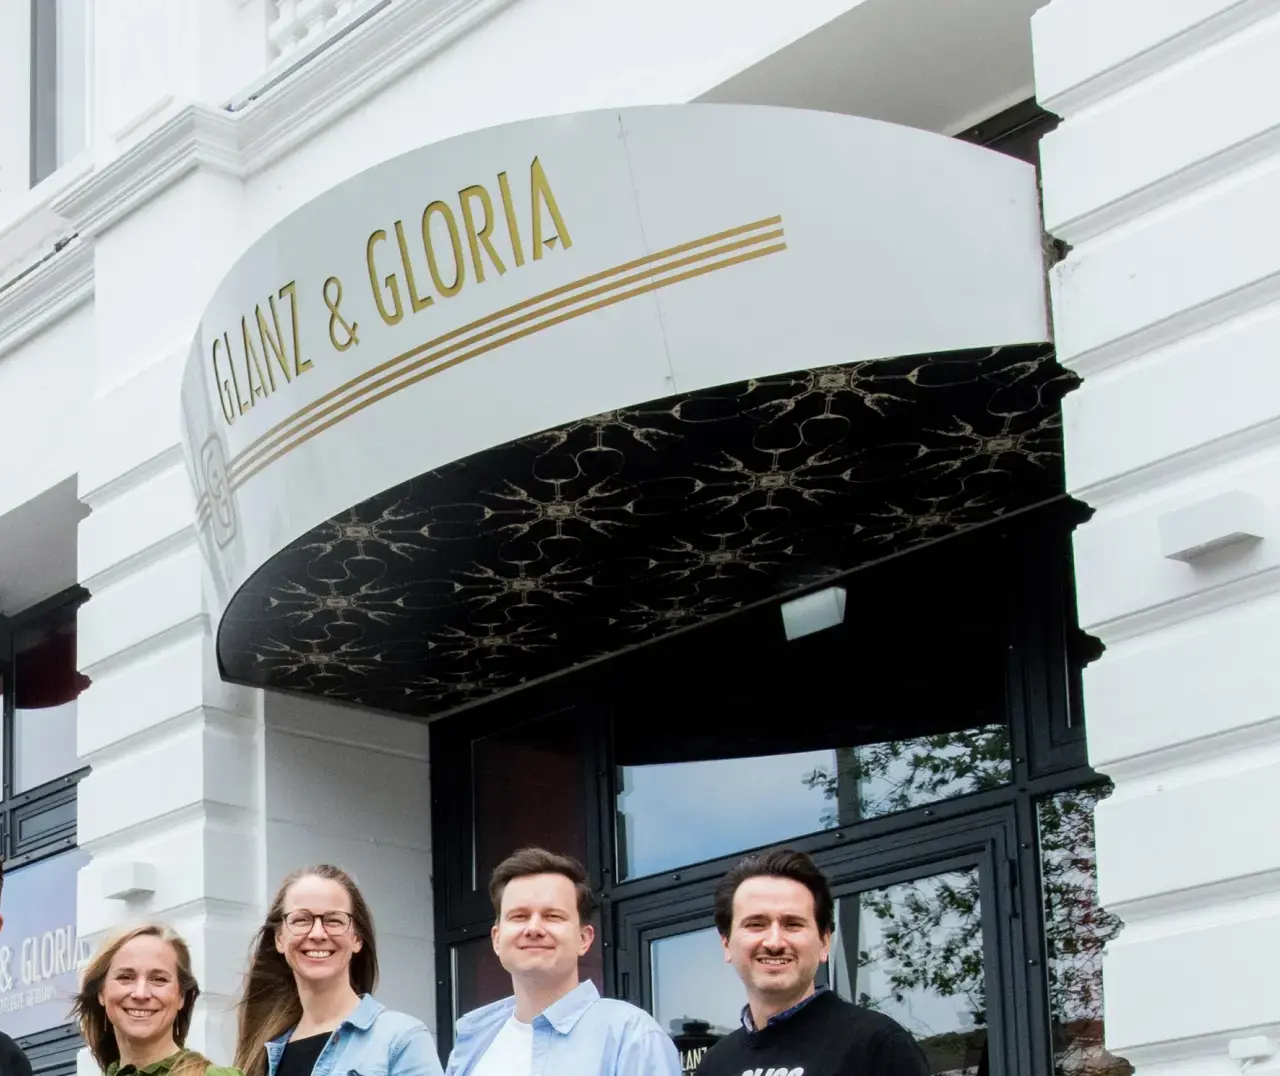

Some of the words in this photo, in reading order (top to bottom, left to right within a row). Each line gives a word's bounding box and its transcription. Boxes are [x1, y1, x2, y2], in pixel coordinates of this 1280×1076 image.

[212, 280, 314, 426] GLANZ
[323, 276, 359, 352] &
[366, 156, 573, 327] GLORIA
[680, 1046, 708, 1072] LAN
